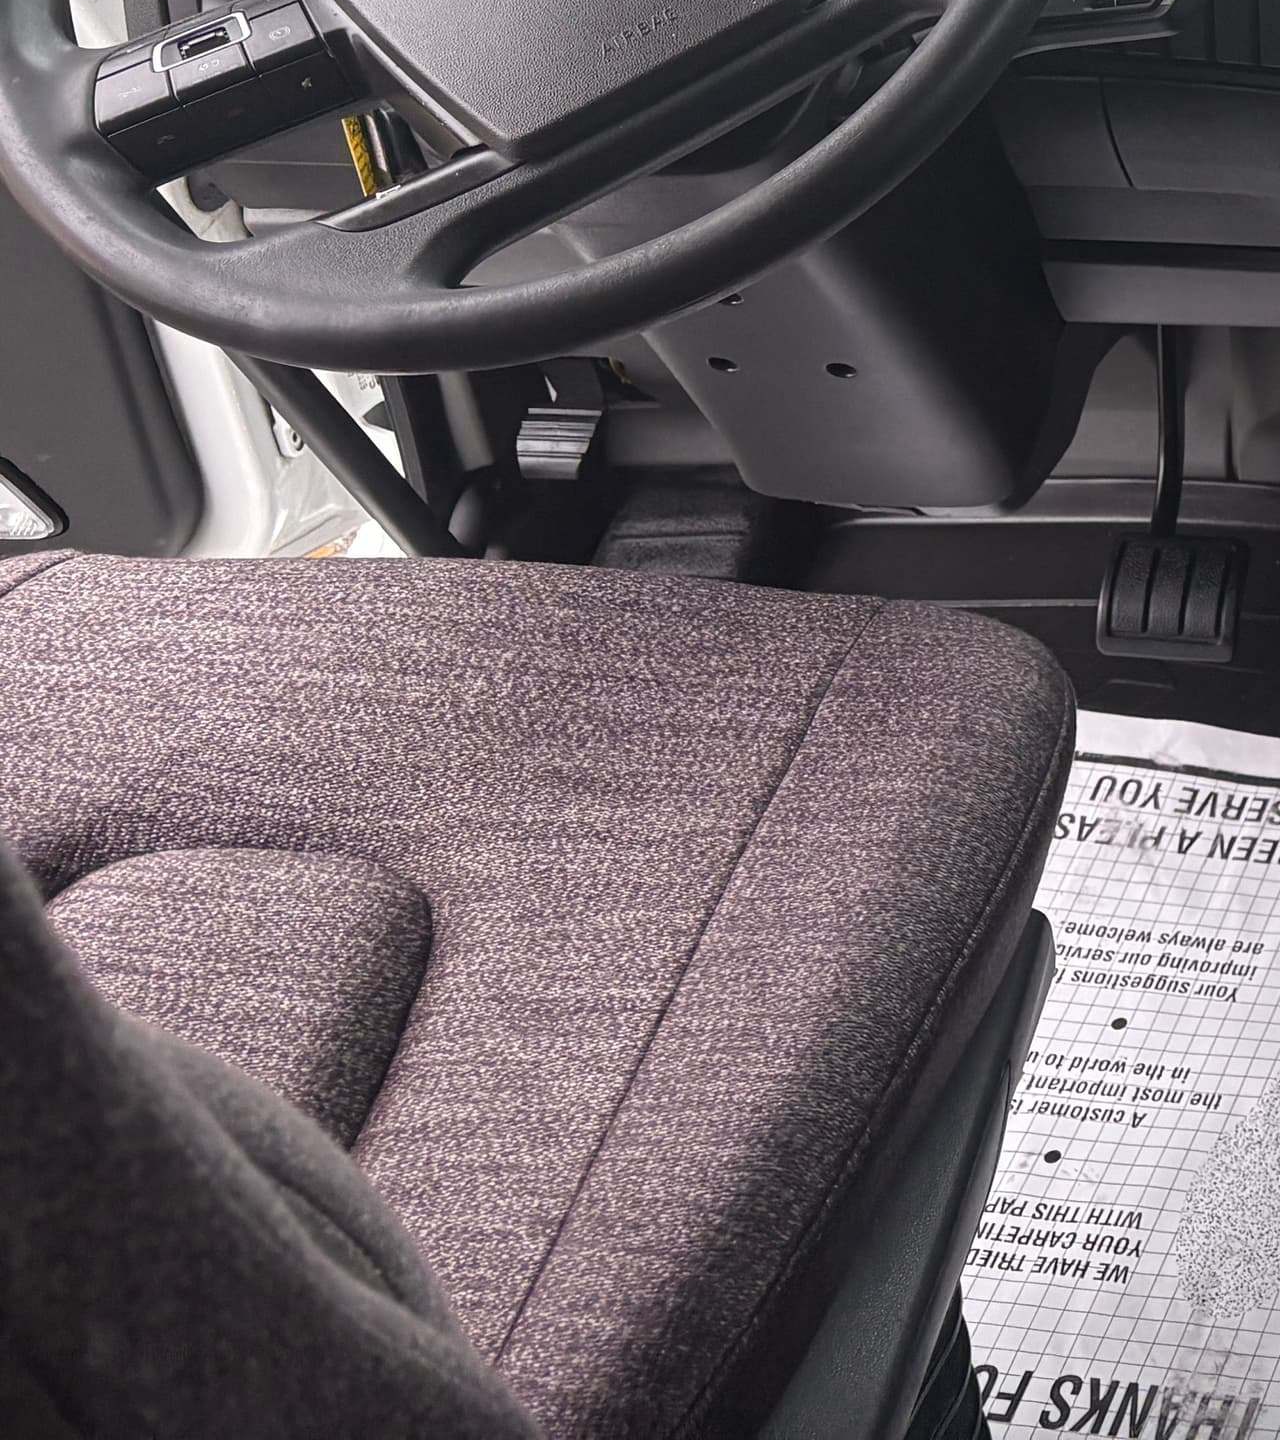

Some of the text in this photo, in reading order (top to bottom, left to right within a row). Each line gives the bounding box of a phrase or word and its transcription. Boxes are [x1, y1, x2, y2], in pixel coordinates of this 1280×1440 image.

[600, 6, 679, 57] AIRBAG
[1090, 774, 1163, 810] YOU
[1177, 827, 1203, 855] A
[1157, 931, 1227, 952] always
[1231, 939, 1265, 955] are
[1118, 951, 1155, 964] our
[1157, 952, 1259, 981] improving
[1070, 968, 1192, 995] suggestions
[1193, 982, 1239, 1003] Your
[1044, 1051, 1067, 1064] to
[1067, 1054, 1127, 1075] world
[1132, 1061, 1167, 1081] the
[1171, 1066, 1192, 1085] in
[1025, 1074, 1224, 1111] the most important
[1026, 1099, 1127, 1124] customer
[1130, 1111, 1149, 1129] A
[1031, 1202, 1081, 1225] THIS
[1086, 1206, 1144, 1231] WITH
[1082, 1233, 1143, 1258] YOUR
[965, 1247, 1131, 1285] WE HAVE TRIED
